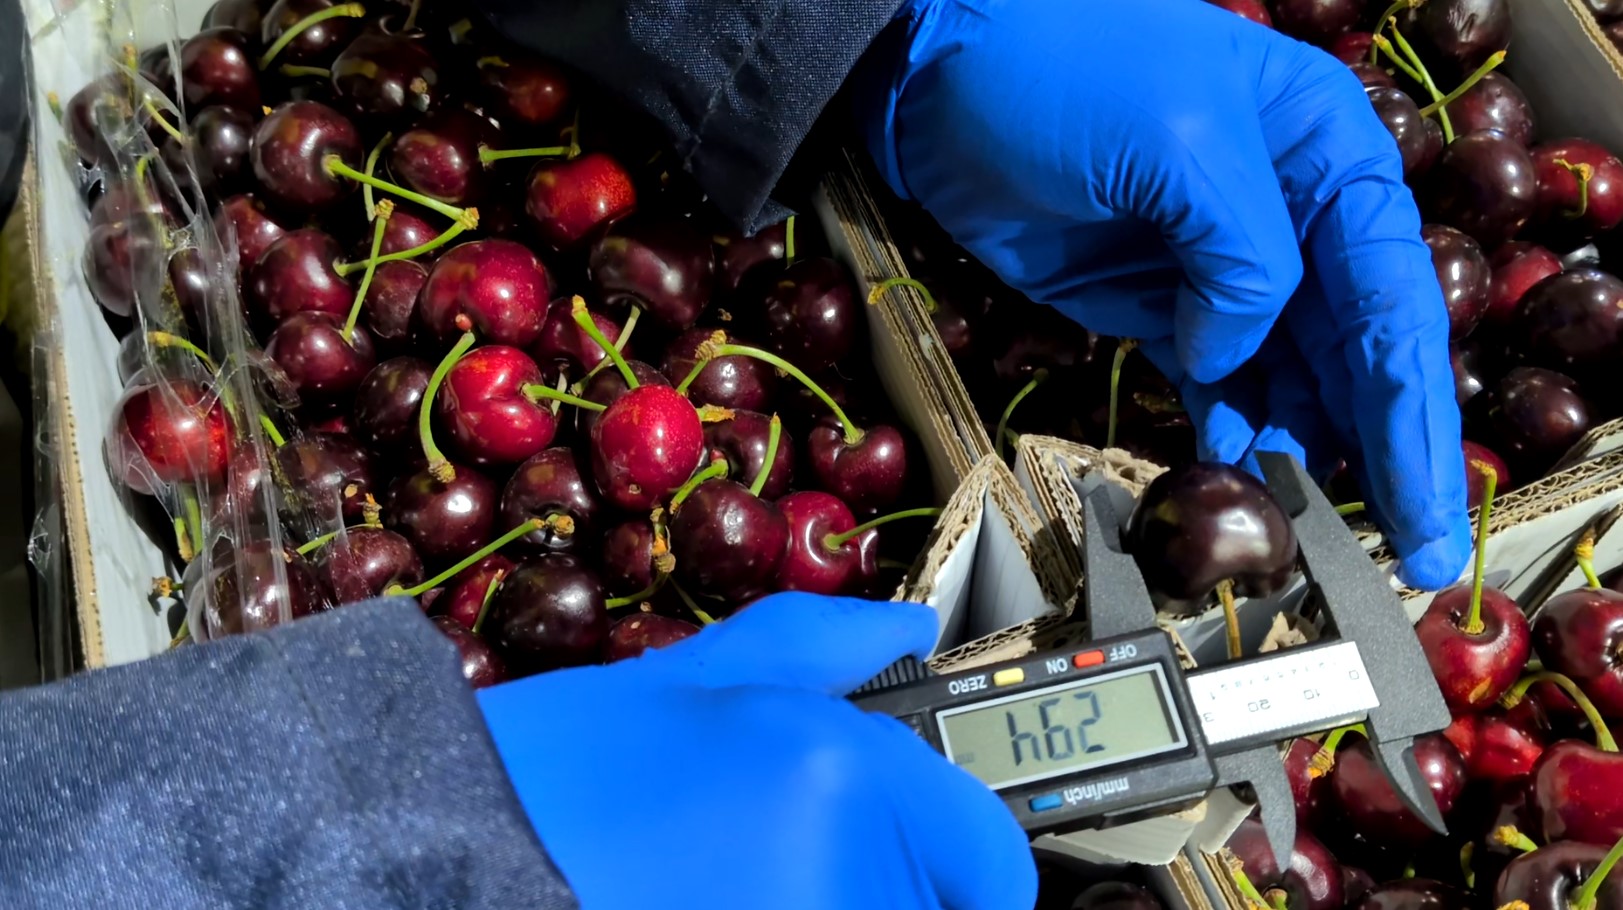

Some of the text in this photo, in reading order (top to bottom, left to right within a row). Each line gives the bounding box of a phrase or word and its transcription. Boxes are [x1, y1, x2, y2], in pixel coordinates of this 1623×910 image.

[949, 644, 1137, 695] OFF ON ZERO
[1303, 689, 1321, 700] 10
[1248, 699, 1271, 712] 20
[1064, 777, 1129, 805] mm/inch
